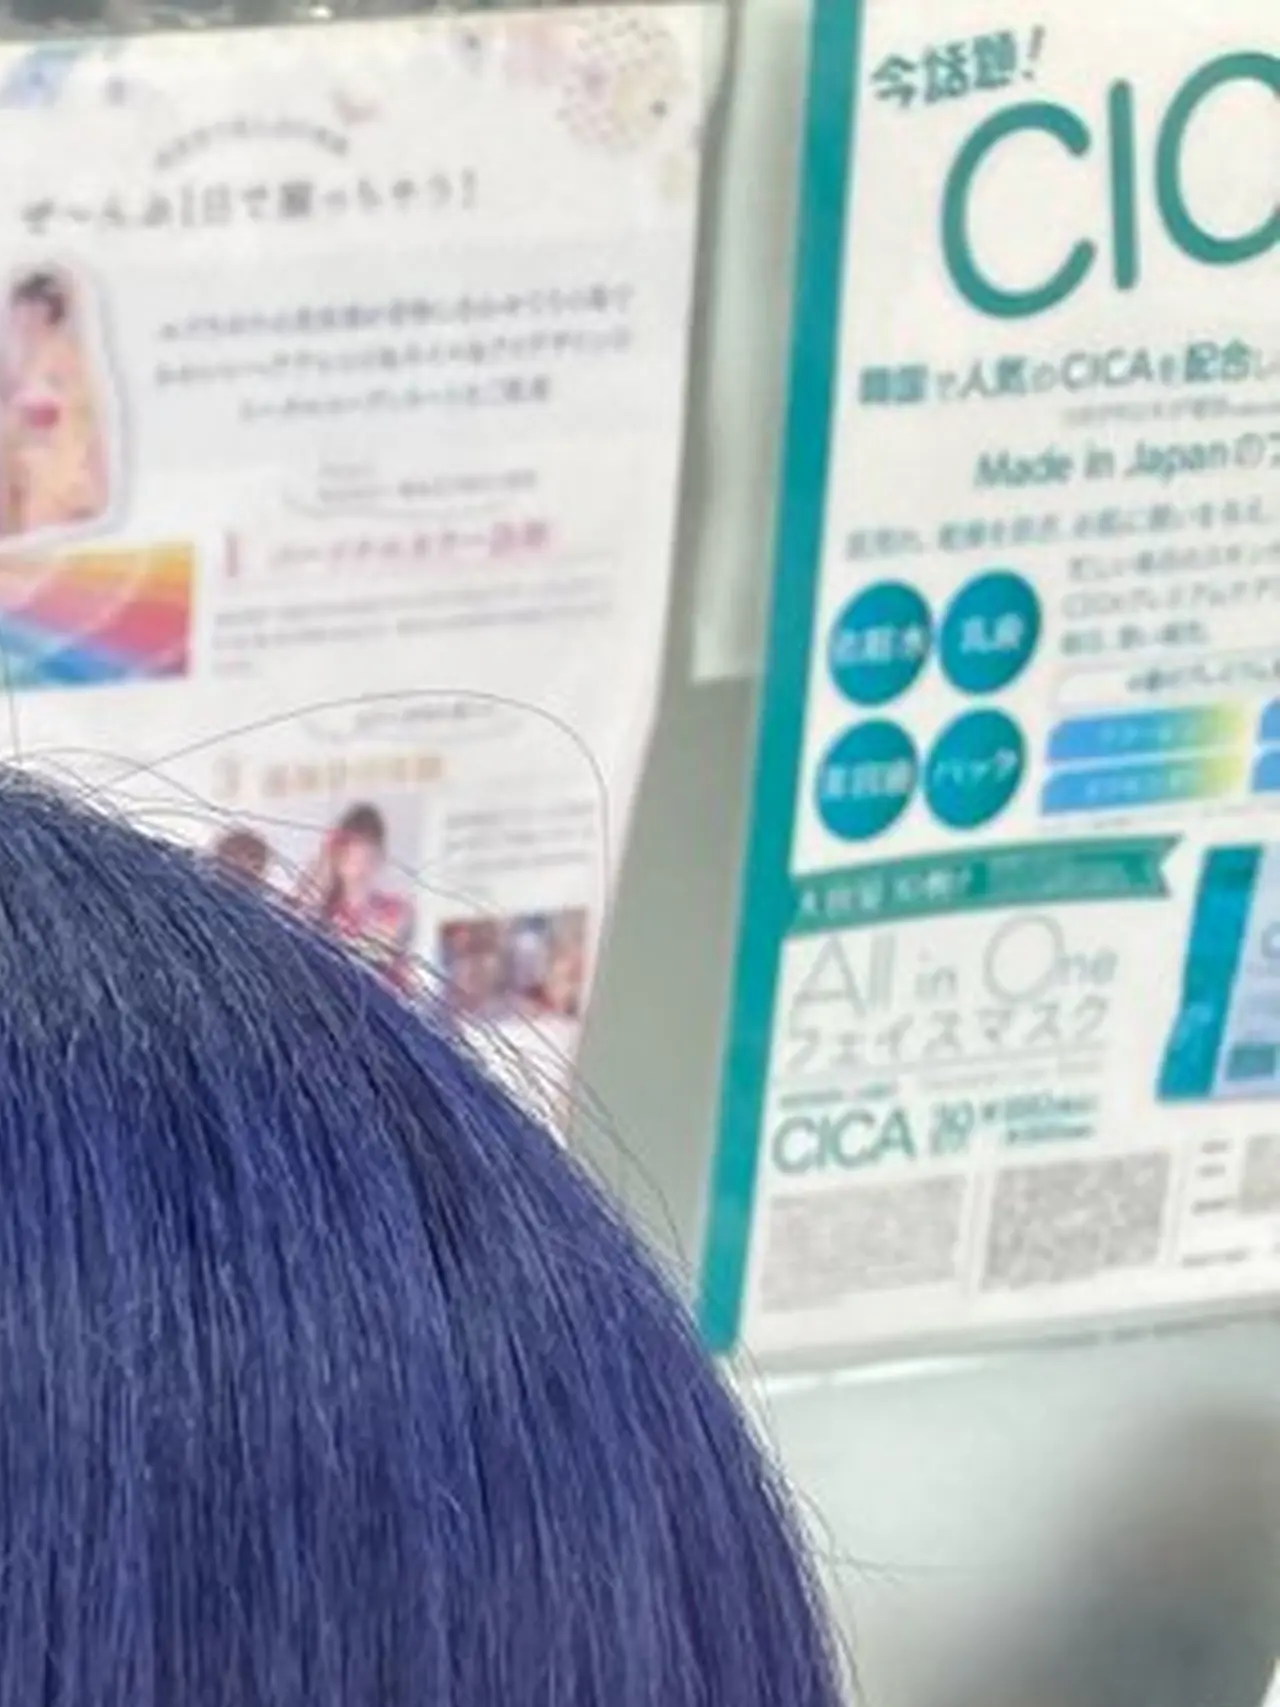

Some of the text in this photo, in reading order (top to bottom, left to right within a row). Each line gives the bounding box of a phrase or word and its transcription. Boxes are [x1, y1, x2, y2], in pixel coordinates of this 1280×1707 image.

[870, 24, 1046, 108] 今話題!
[972, 446, 1075, 489] Made
[1084, 437, 1117, 479] in
[786, 914, 1120, 1020] All in One
[782, 996, 1110, 1076] フェイスマスク
[770, 1106, 918, 1178] CICA
